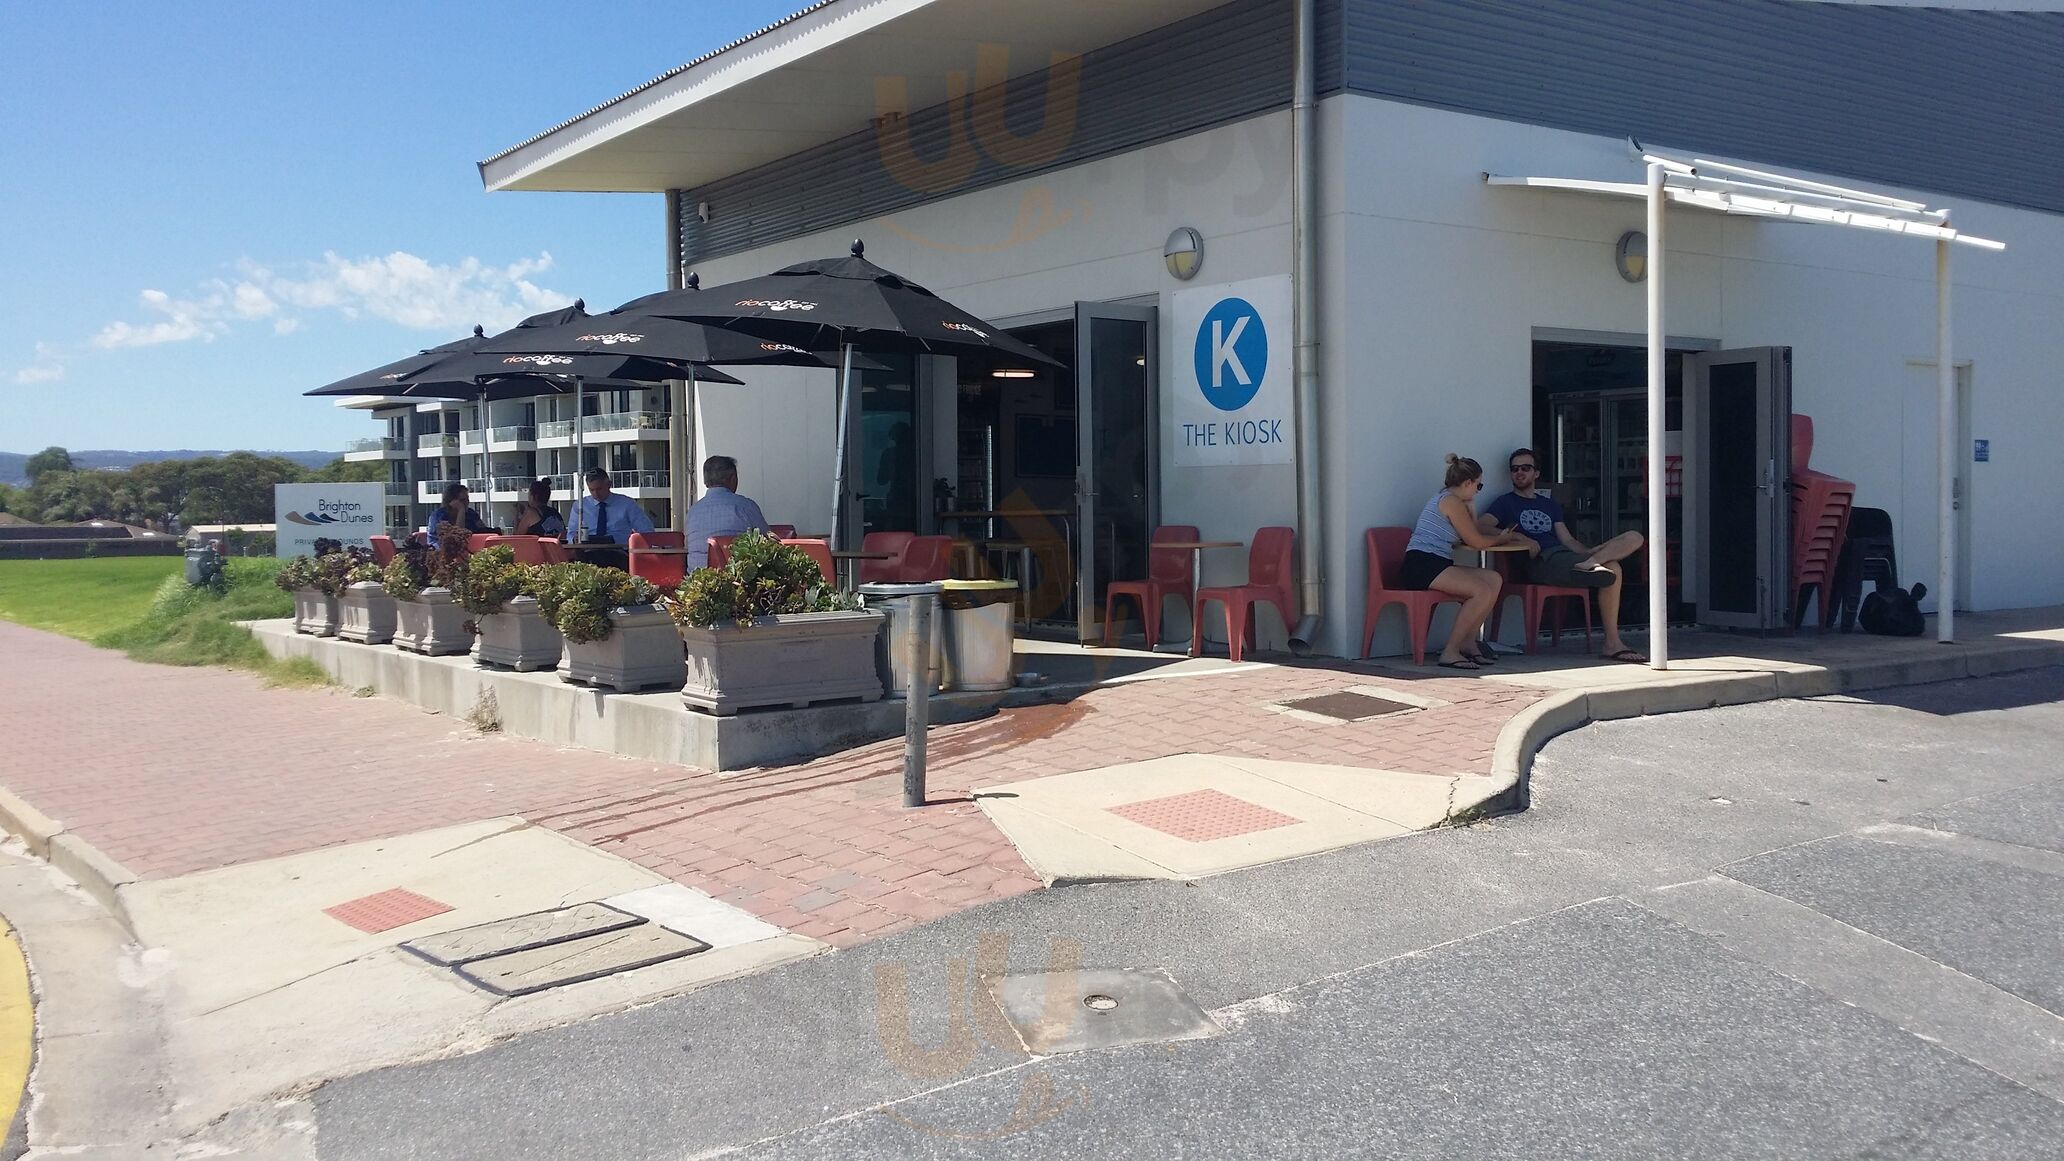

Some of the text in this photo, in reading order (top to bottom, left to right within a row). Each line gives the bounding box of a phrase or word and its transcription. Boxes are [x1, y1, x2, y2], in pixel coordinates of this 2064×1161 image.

[1212, 316, 1252, 388] K
[1183, 419, 1282, 446] THE KIOSK
[318, 499, 361, 514] Brighton
[340, 511, 374, 523] Dunes
